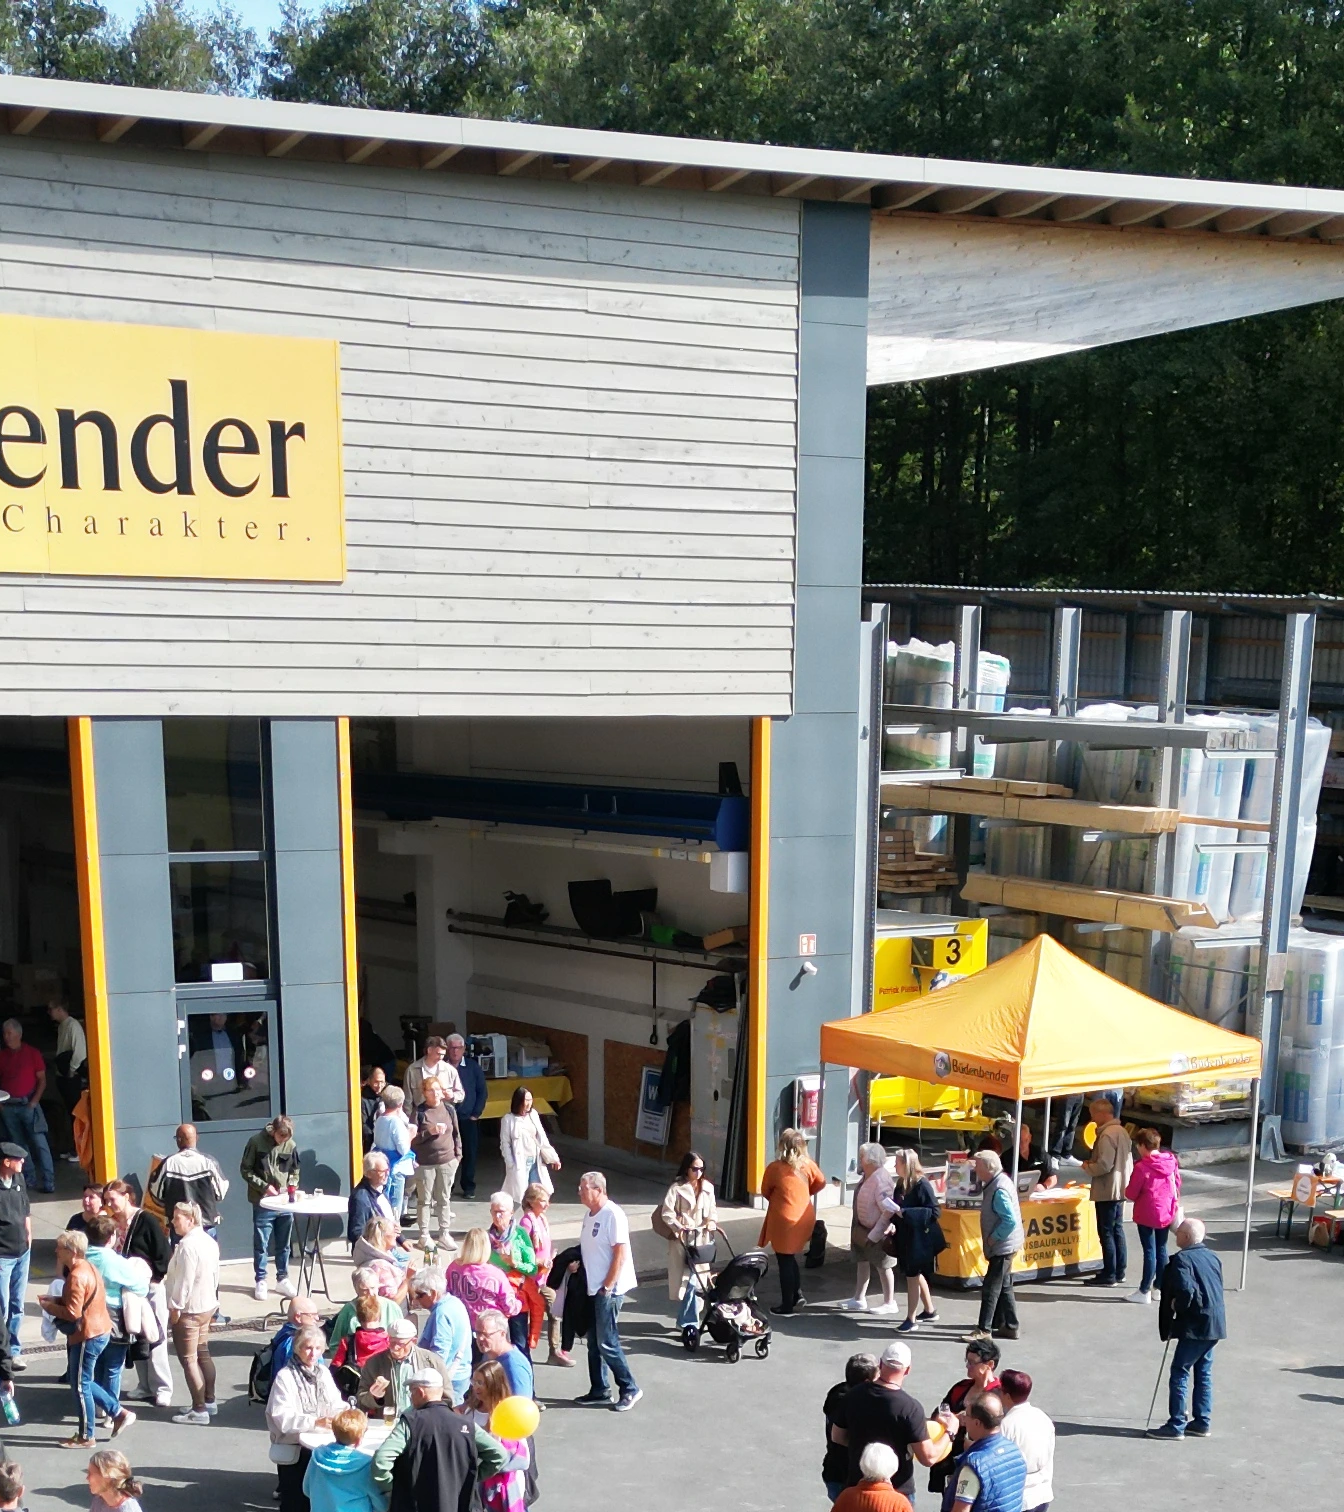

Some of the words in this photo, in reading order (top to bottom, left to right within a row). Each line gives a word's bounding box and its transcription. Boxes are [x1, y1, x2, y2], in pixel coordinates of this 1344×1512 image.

[1, 503, 314, 542] Charakter.
[945, 938, 961, 965] 3
[951, 1058, 1010, 1083] Büdenbender
[1022, 1212, 1081, 1238] ASSE
[1023, 1234, 1081, 1250] USBAURALLYE
